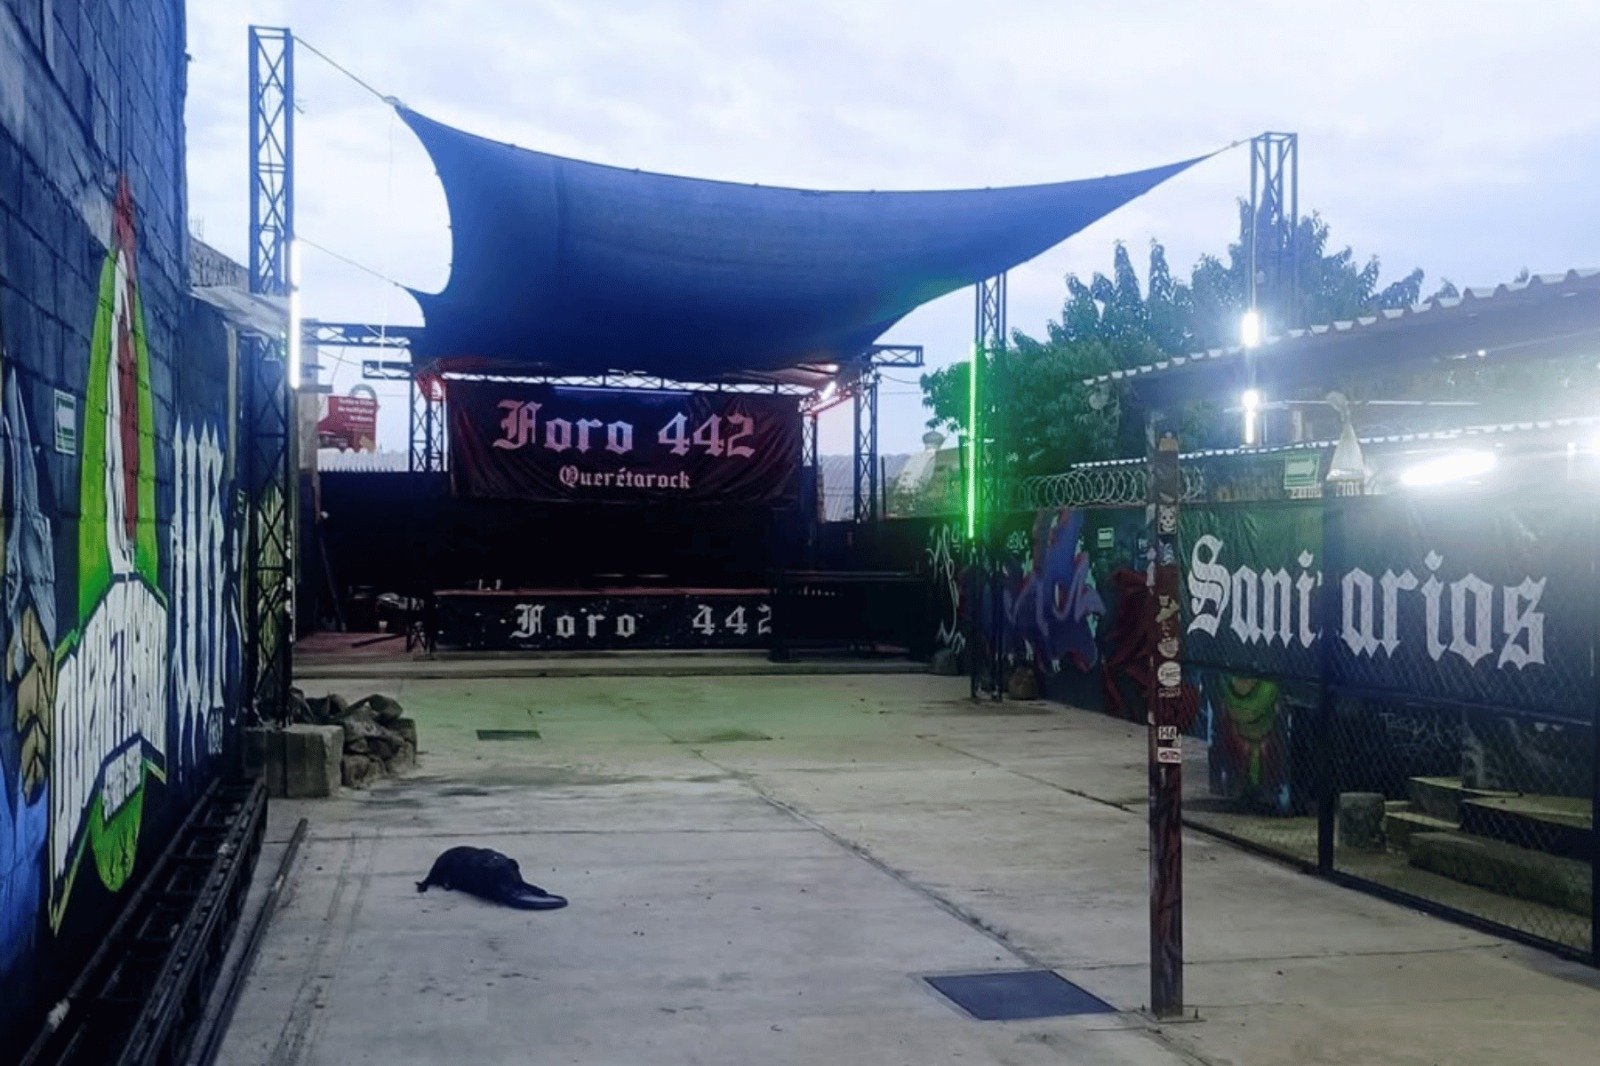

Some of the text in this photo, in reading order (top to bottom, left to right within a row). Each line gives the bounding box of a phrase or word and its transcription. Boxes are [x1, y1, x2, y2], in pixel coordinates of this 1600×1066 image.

[492, 399, 756, 459] Foro 442
[559, 464, 692, 489] Querétarock
[510, 603, 637, 639] Foro
[1186, 533, 1547, 671] Saniarios
